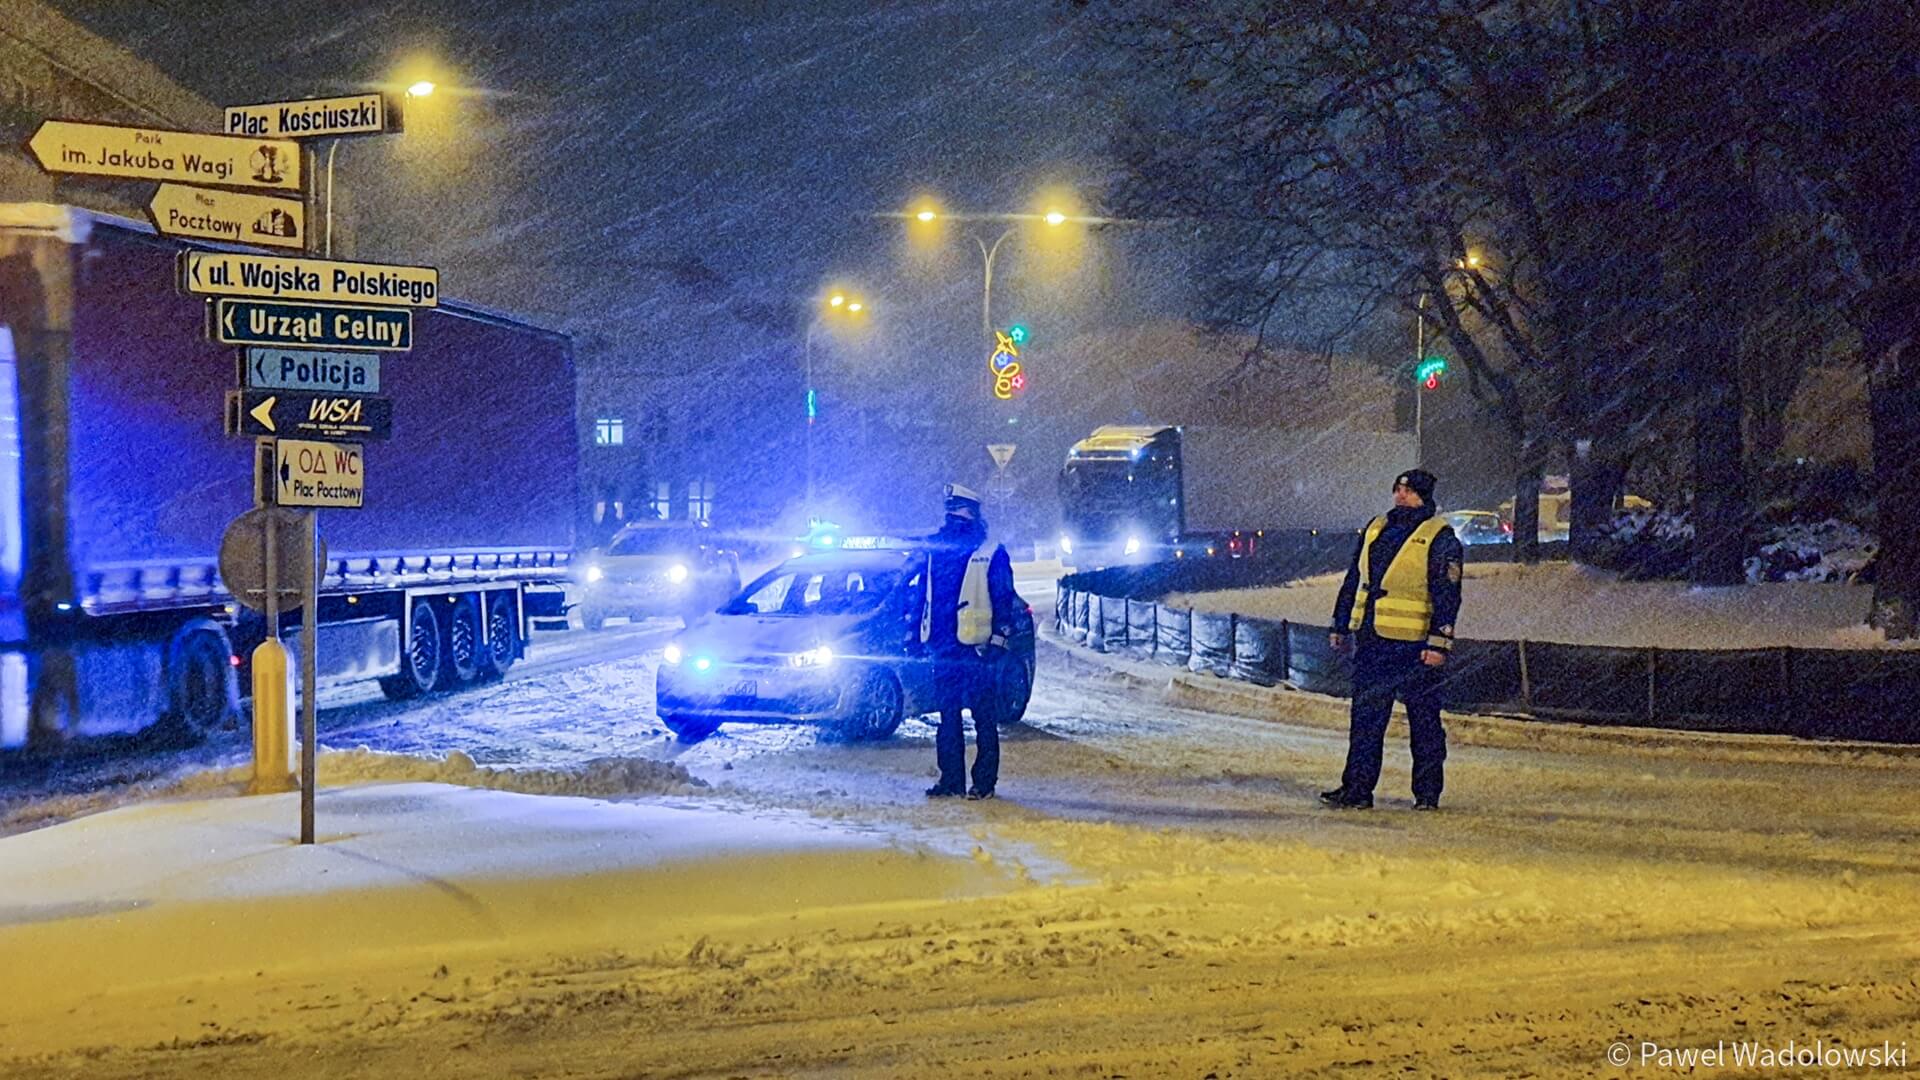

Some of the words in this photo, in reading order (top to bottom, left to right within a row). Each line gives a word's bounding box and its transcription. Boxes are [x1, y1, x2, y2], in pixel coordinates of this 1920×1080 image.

[230, 111, 268, 134] Plac
[278, 100, 377, 133] Kościuszki
[135, 132, 162, 145] Park
[61, 144, 92, 165] im.
[97, 147, 175, 171] Jakuba
[182, 153, 233, 180] Wagi
[169, 209, 242, 239] Pocztowy
[209, 265, 235, 287] ul.
[241, 262, 320, 293] Wojska
[332, 269, 435, 304] Polskiego
[249, 309, 322, 344] Urząd
[335, 316, 403, 346] Celny
[281, 356, 366, 389] Policja
[308, 398, 362, 423] WSA
[334, 449, 359, 475] WC
[293, 479, 314, 498] Plac
[316, 480, 361, 501] Pocztowy
